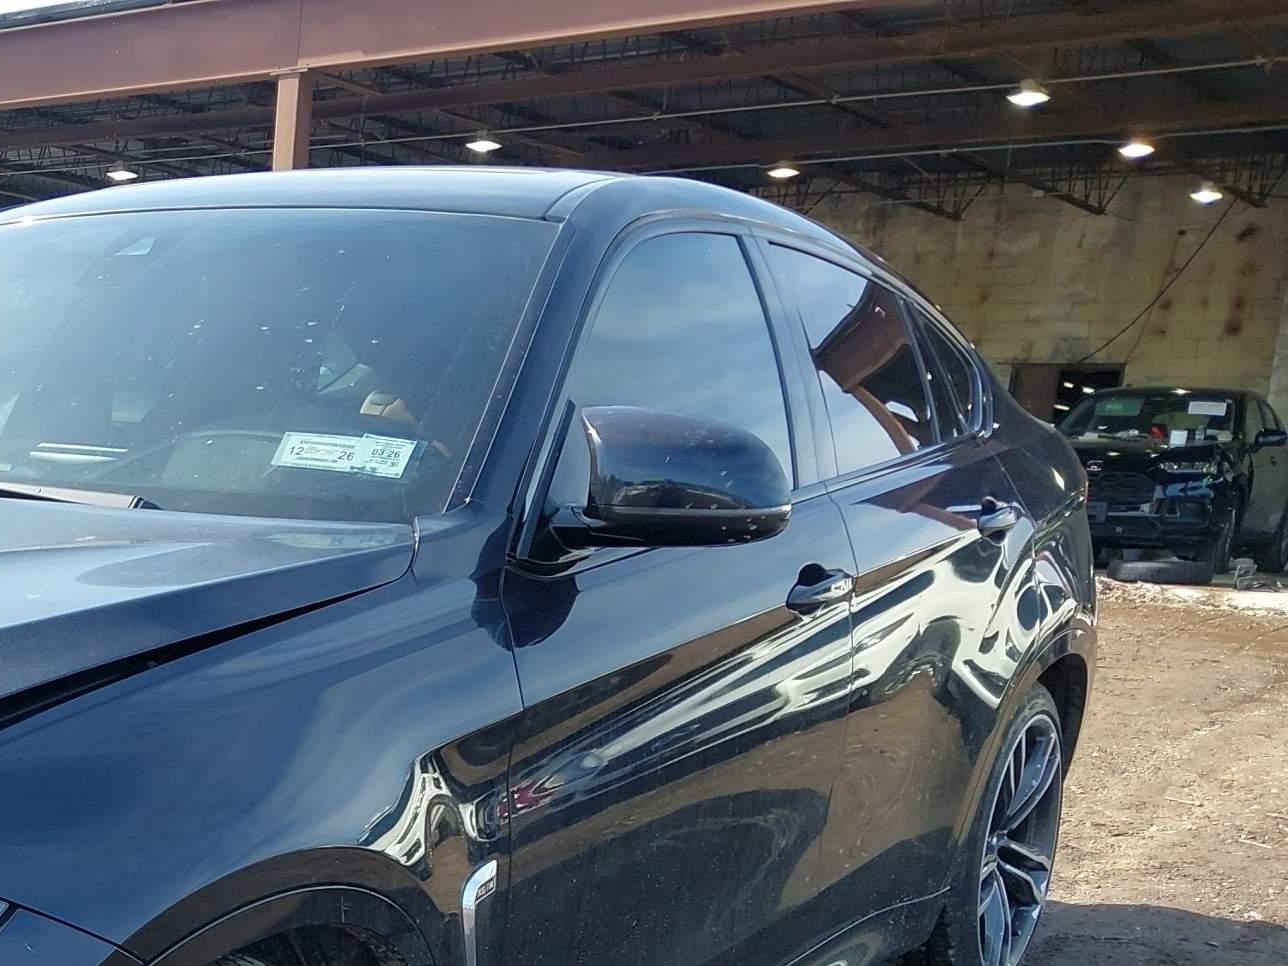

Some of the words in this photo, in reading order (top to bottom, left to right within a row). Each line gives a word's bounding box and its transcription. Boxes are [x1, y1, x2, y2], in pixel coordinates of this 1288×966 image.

[289, 446, 305, 456] 12
[336, 450, 356, 462] 26
[371, 448, 386, 456] 03
[386, 449, 401, 459] 26
